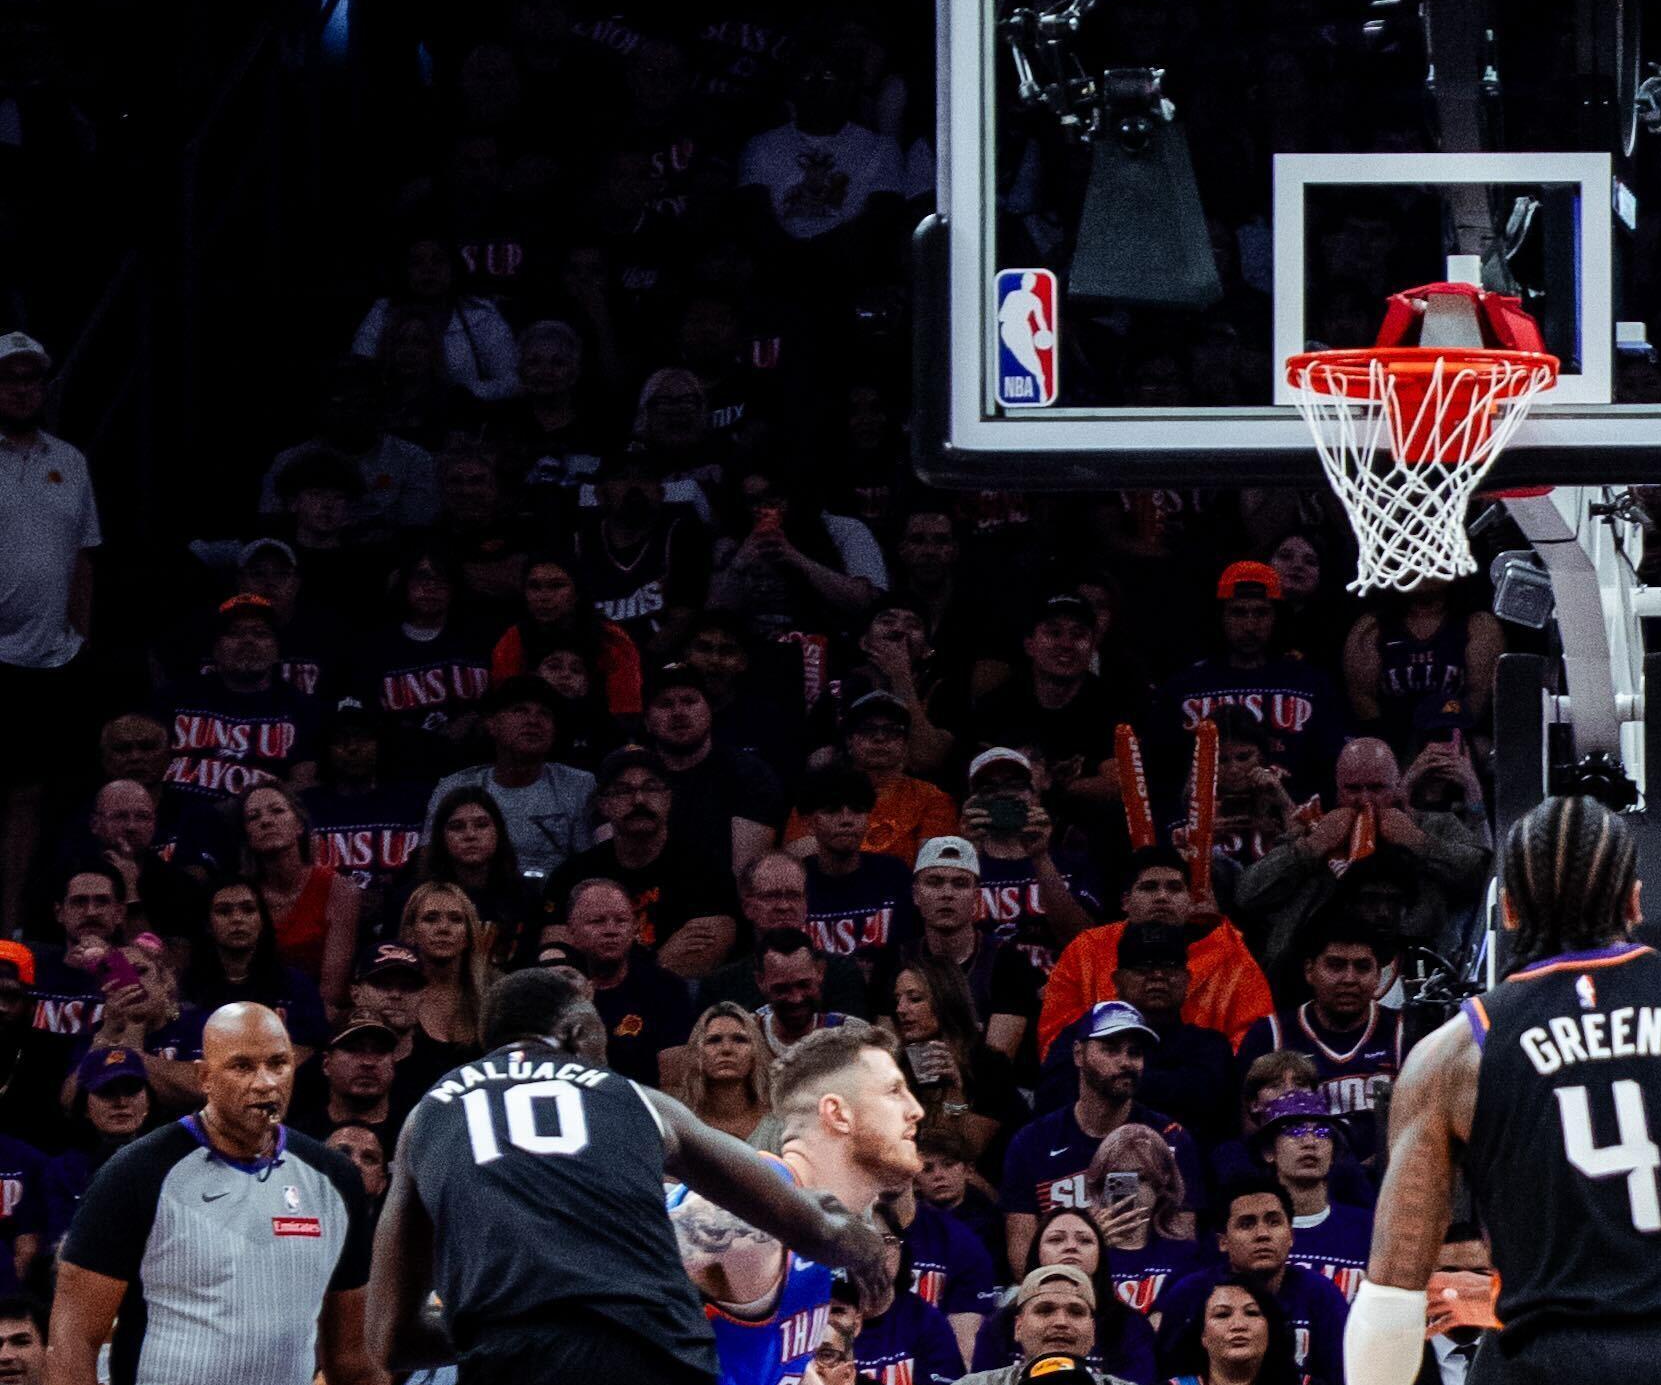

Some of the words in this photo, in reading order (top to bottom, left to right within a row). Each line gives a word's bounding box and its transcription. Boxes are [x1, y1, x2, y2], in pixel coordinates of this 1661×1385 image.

[1003, 375, 1034, 399] NBA
[1272, 695, 1314, 733] UP
[172, 713, 251, 750] SUNS
[256, 719, 296, 758] UP
[382, 828, 421, 867] UP
[428, 1059, 606, 1104] MALUACH
[460, 1079, 592, 1166] 10
